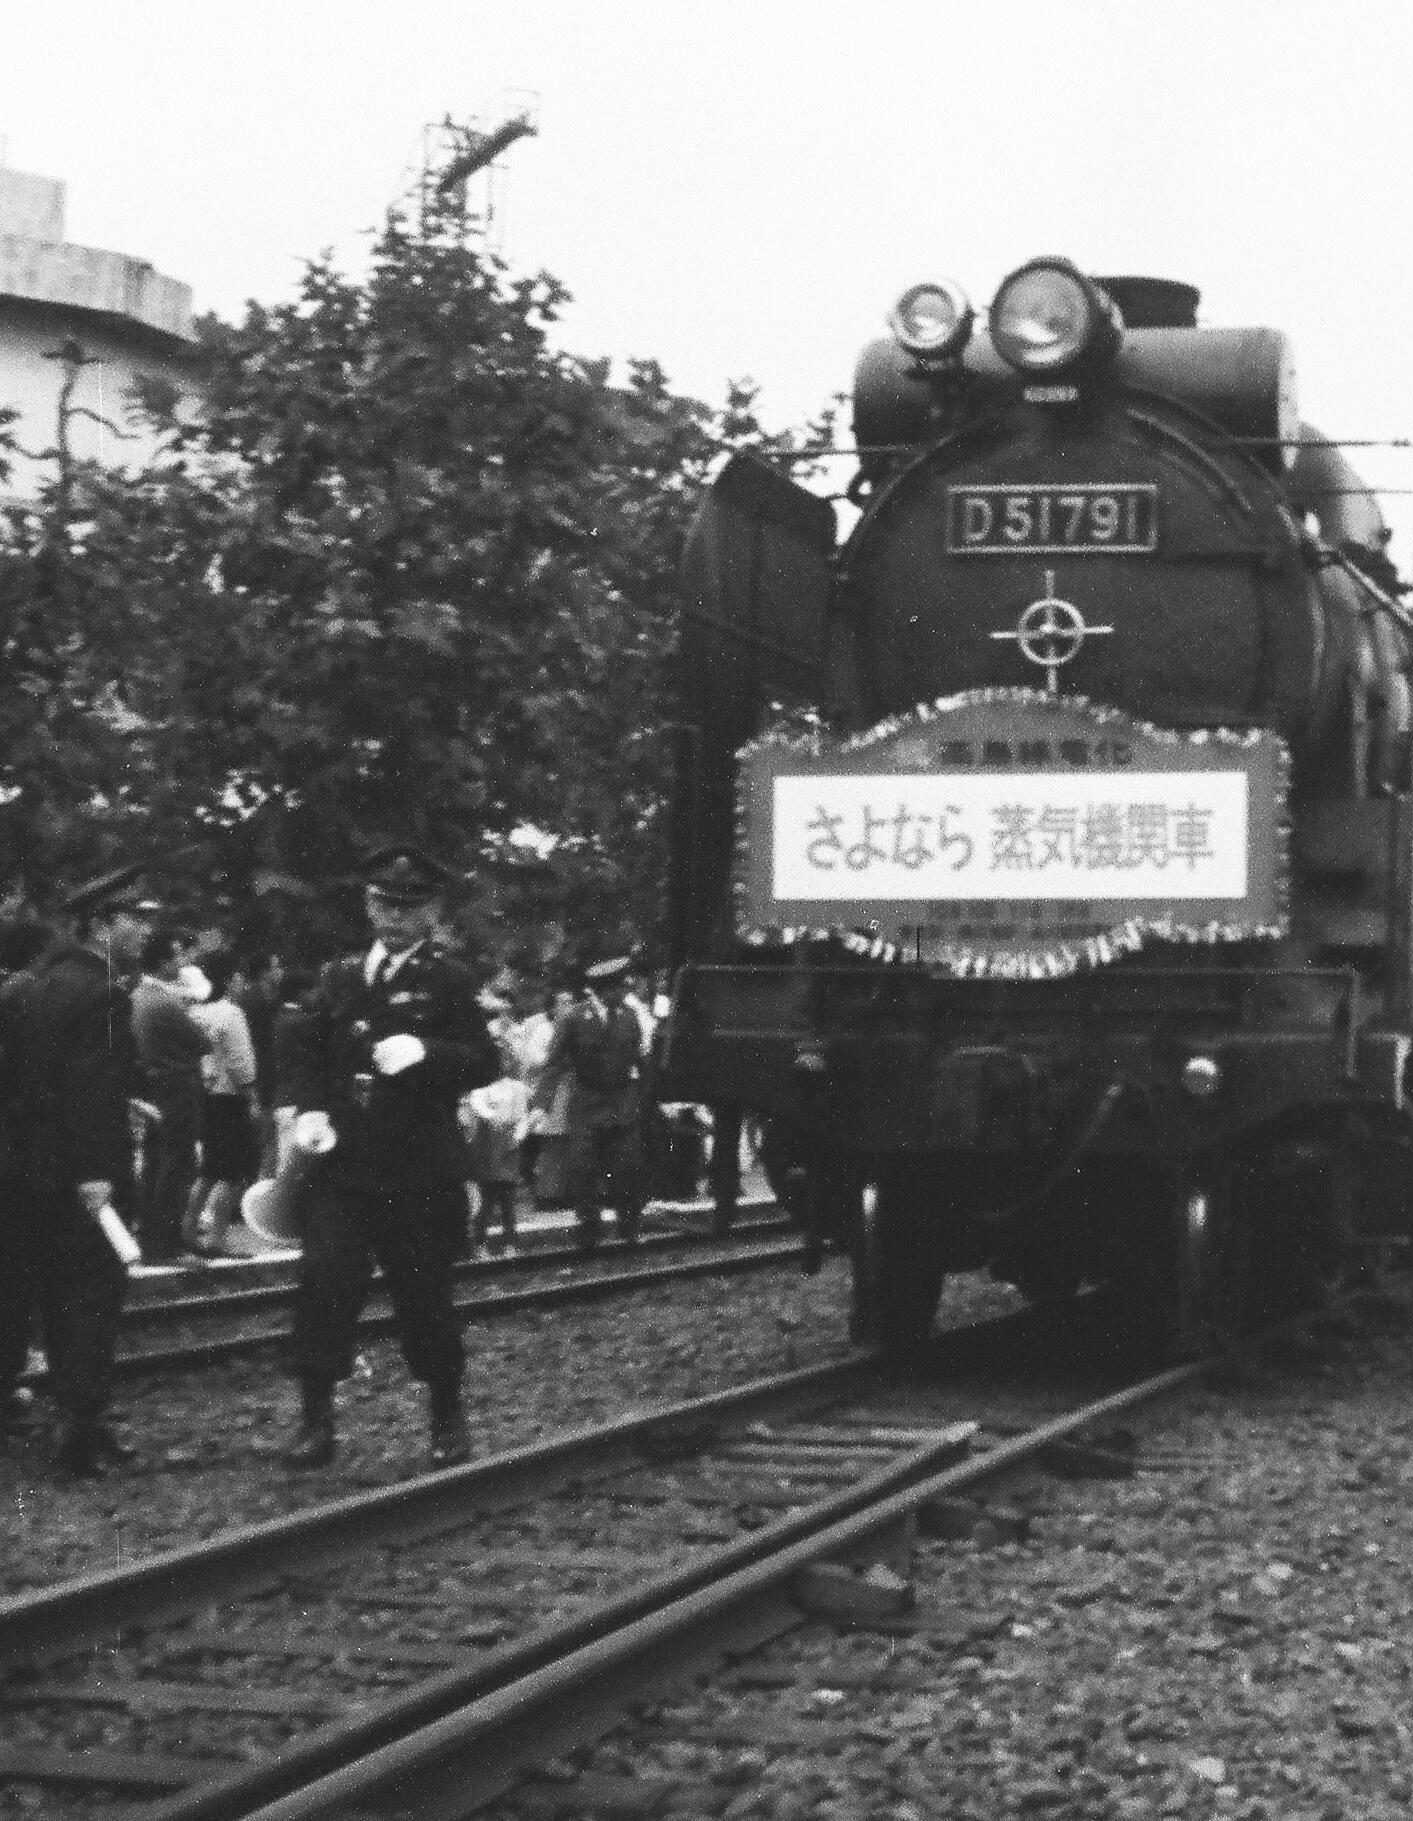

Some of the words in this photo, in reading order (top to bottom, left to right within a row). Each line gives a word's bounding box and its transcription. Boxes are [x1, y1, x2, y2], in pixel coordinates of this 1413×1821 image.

[963, 496, 1139, 541] D51791
[806, 803, 974, 871] さよなら
[989, 802, 1214, 871] 蒸気機関車
